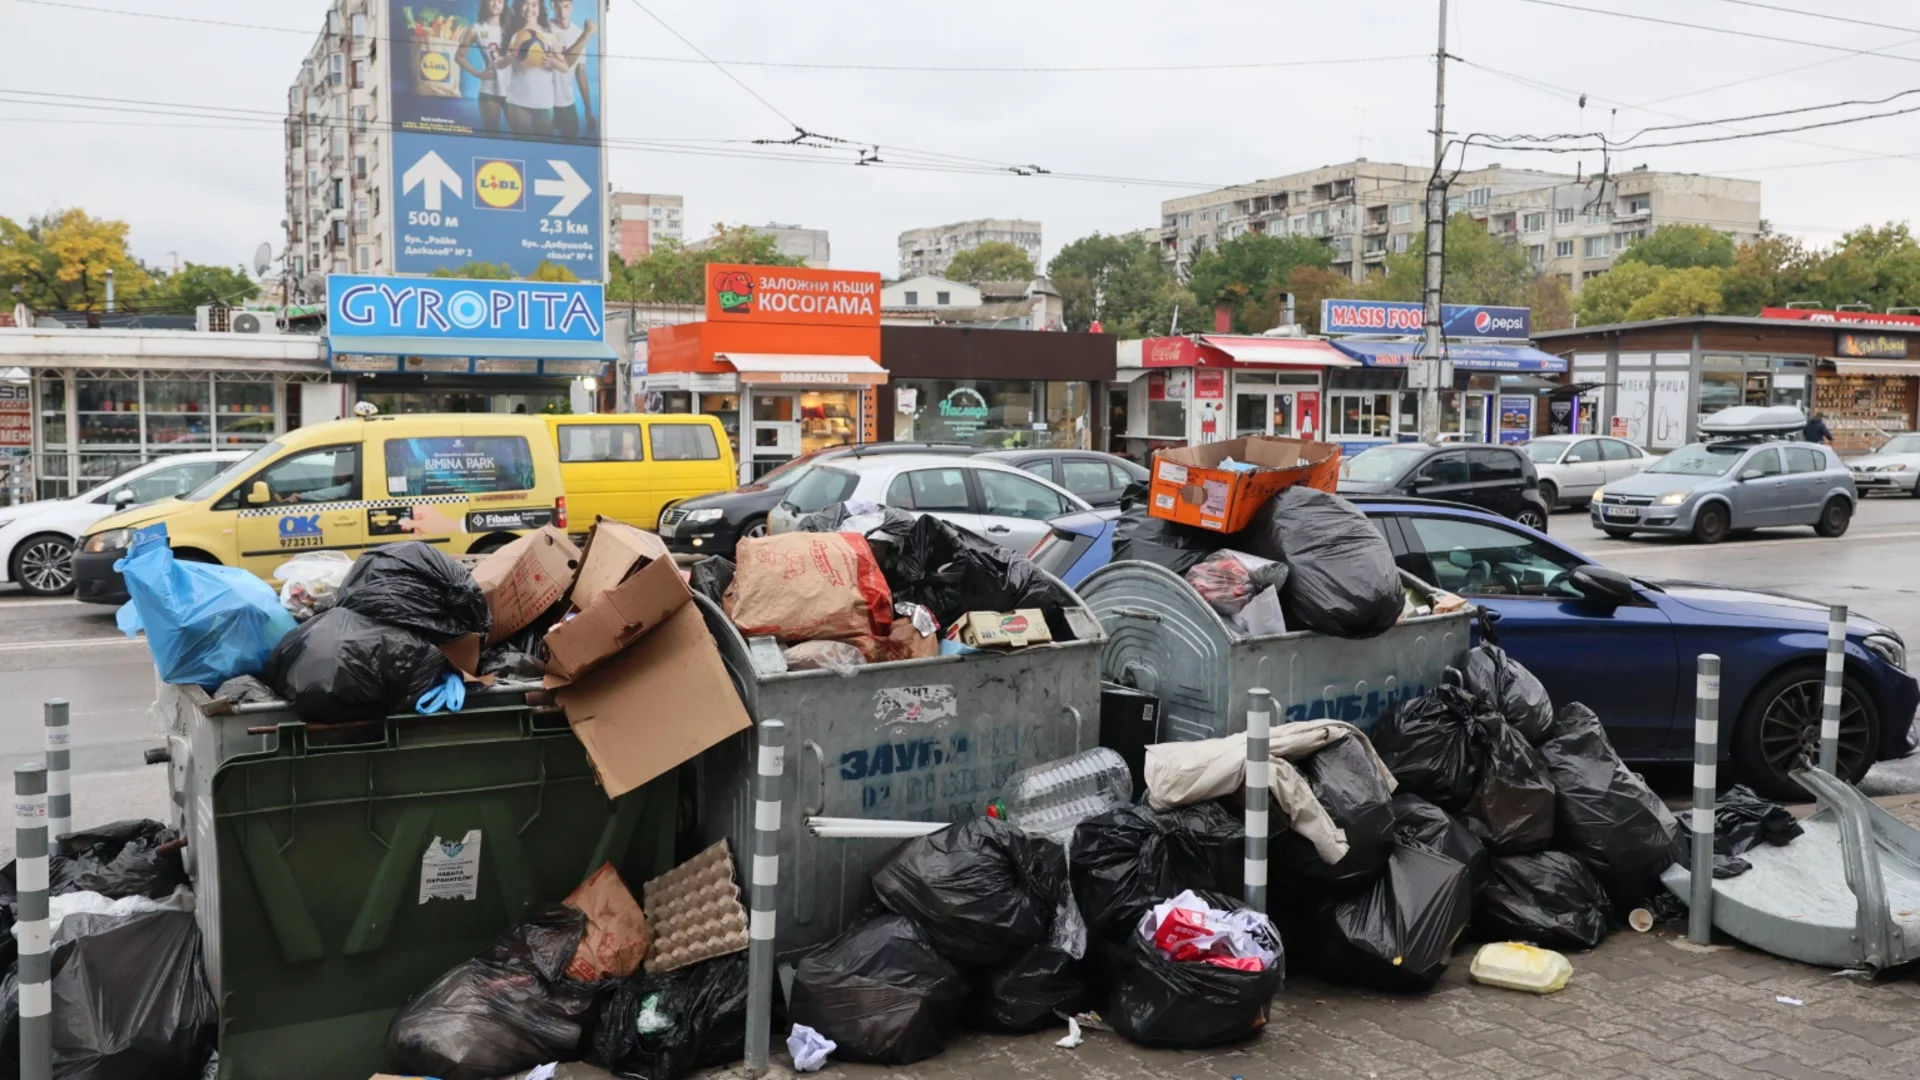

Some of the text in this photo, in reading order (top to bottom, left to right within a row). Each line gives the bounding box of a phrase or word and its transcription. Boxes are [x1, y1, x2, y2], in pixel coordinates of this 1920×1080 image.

[480, 176, 519, 190] LIDL
[408, 211, 458, 228] 500 м
[540, 219, 563, 235] 2,3
[759, 276, 875, 295] ЗАЛОЖНИ КЪЩИ
[339, 283, 600, 336] GYROPITA
[758, 293, 874, 315] КОСОГАМА
[1331, 305, 1384, 328] MASIS
[1491, 316, 1524, 330] pepsi
[465, 457, 495, 469] PARK
[486, 514, 521, 524] Fibank
[280, 536, 323, 548] 9732121
